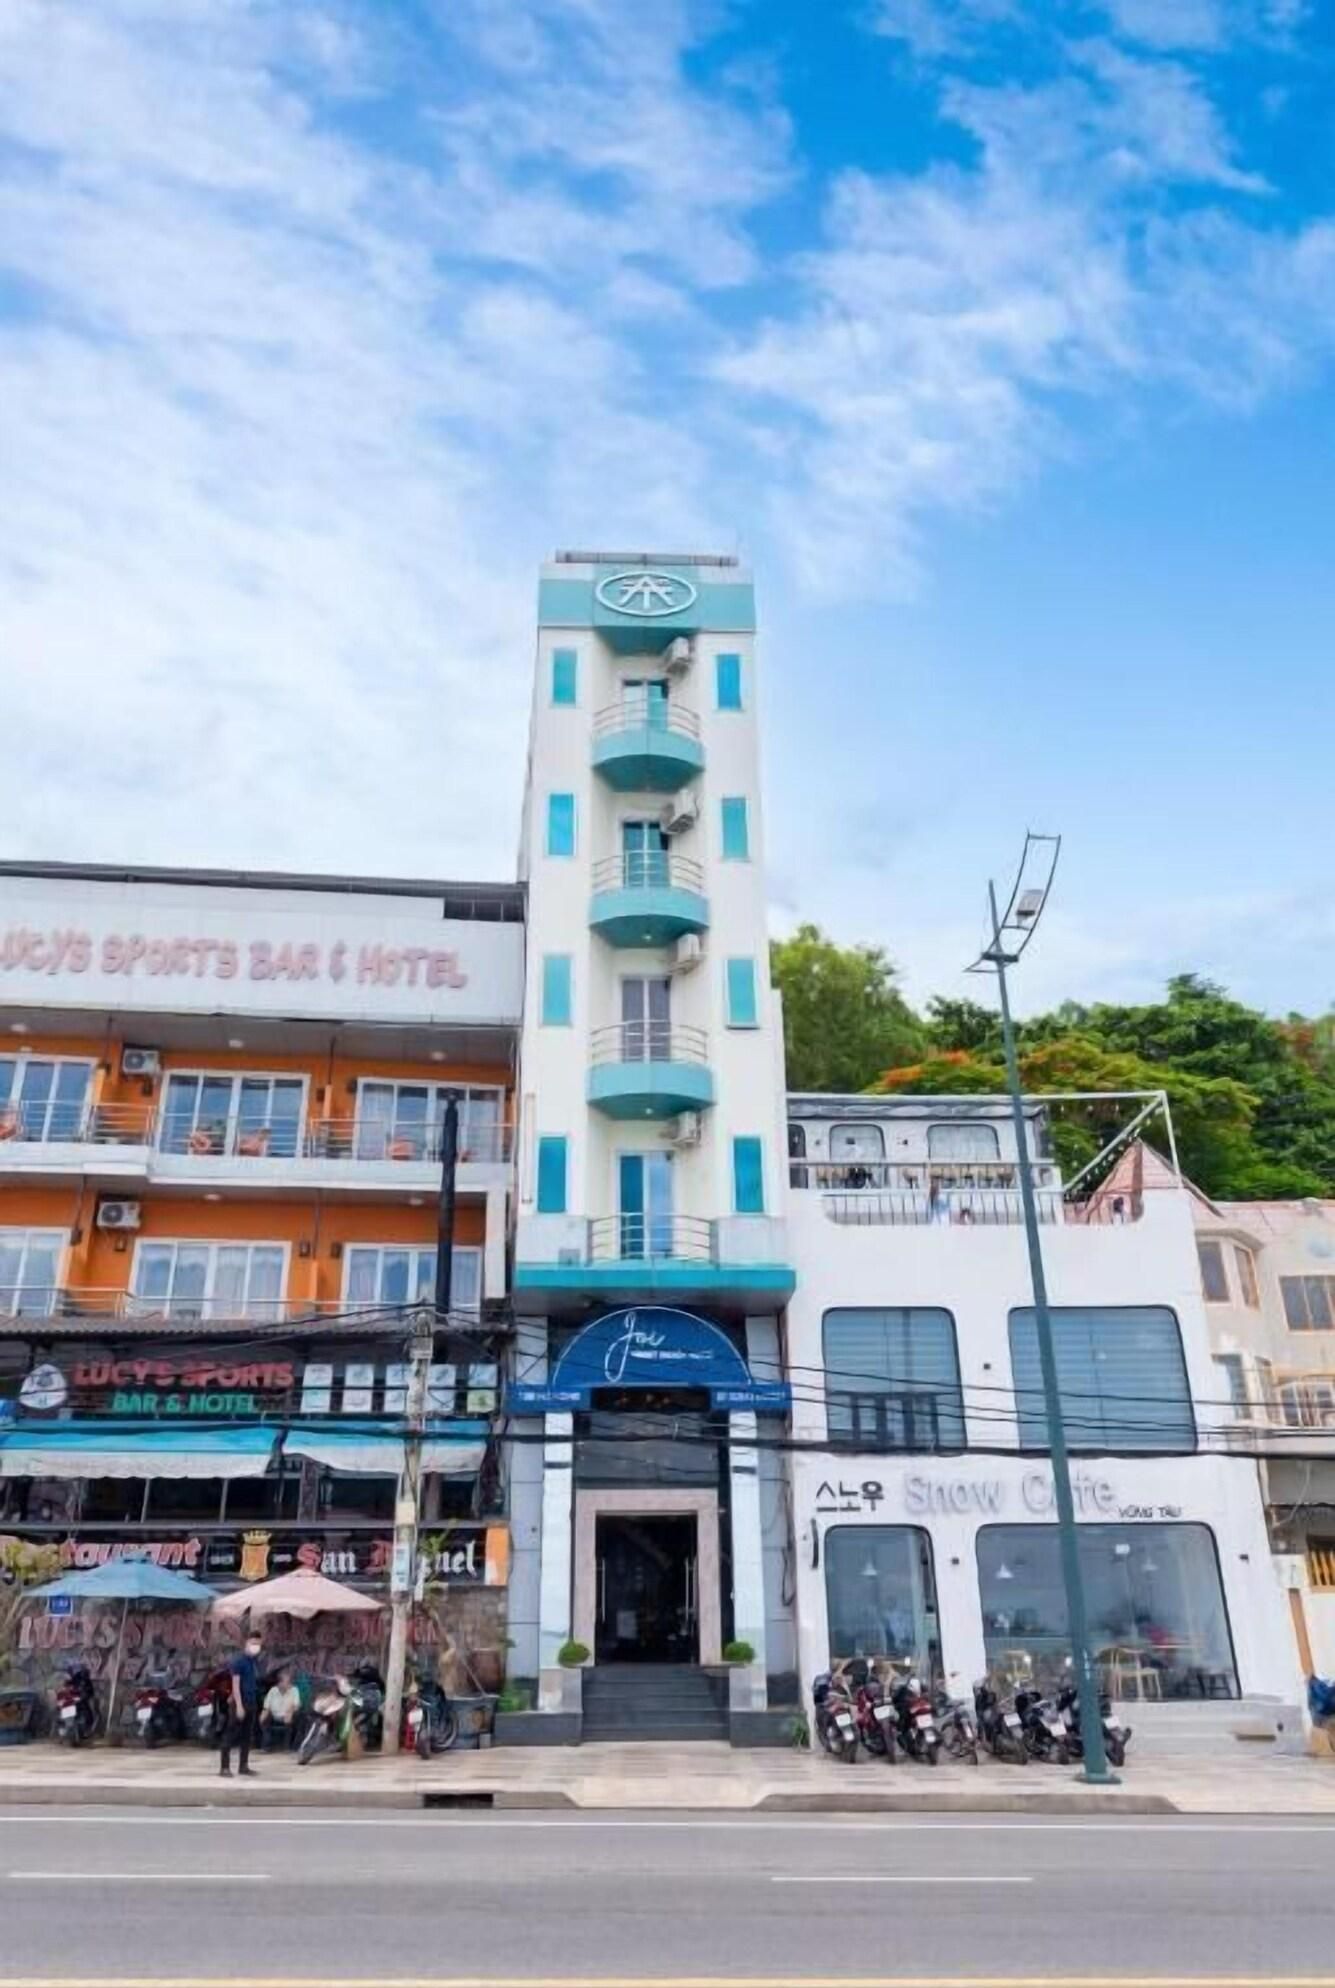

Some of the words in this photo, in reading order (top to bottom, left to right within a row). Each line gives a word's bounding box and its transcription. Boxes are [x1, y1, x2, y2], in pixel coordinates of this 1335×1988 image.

[0, 927, 92, 975] UCY'S
[100, 934, 238, 980] SPORTS
[249, 939, 320, 982] BAR
[356, 942, 469, 989] HOTEL
[180, 1361, 294, 1387] SPORTS
[112, 1392, 157, 1414] BAR
[165, 1393, 182, 1413] &
[188, 1392, 258, 1414] HOTEL
[815, 1480, 885, 1513] 스노우
[904, 1474, 1005, 1516] Snow
[1022, 1470, 1116, 1515] Cfe
[297, 1542, 356, 1573] San
